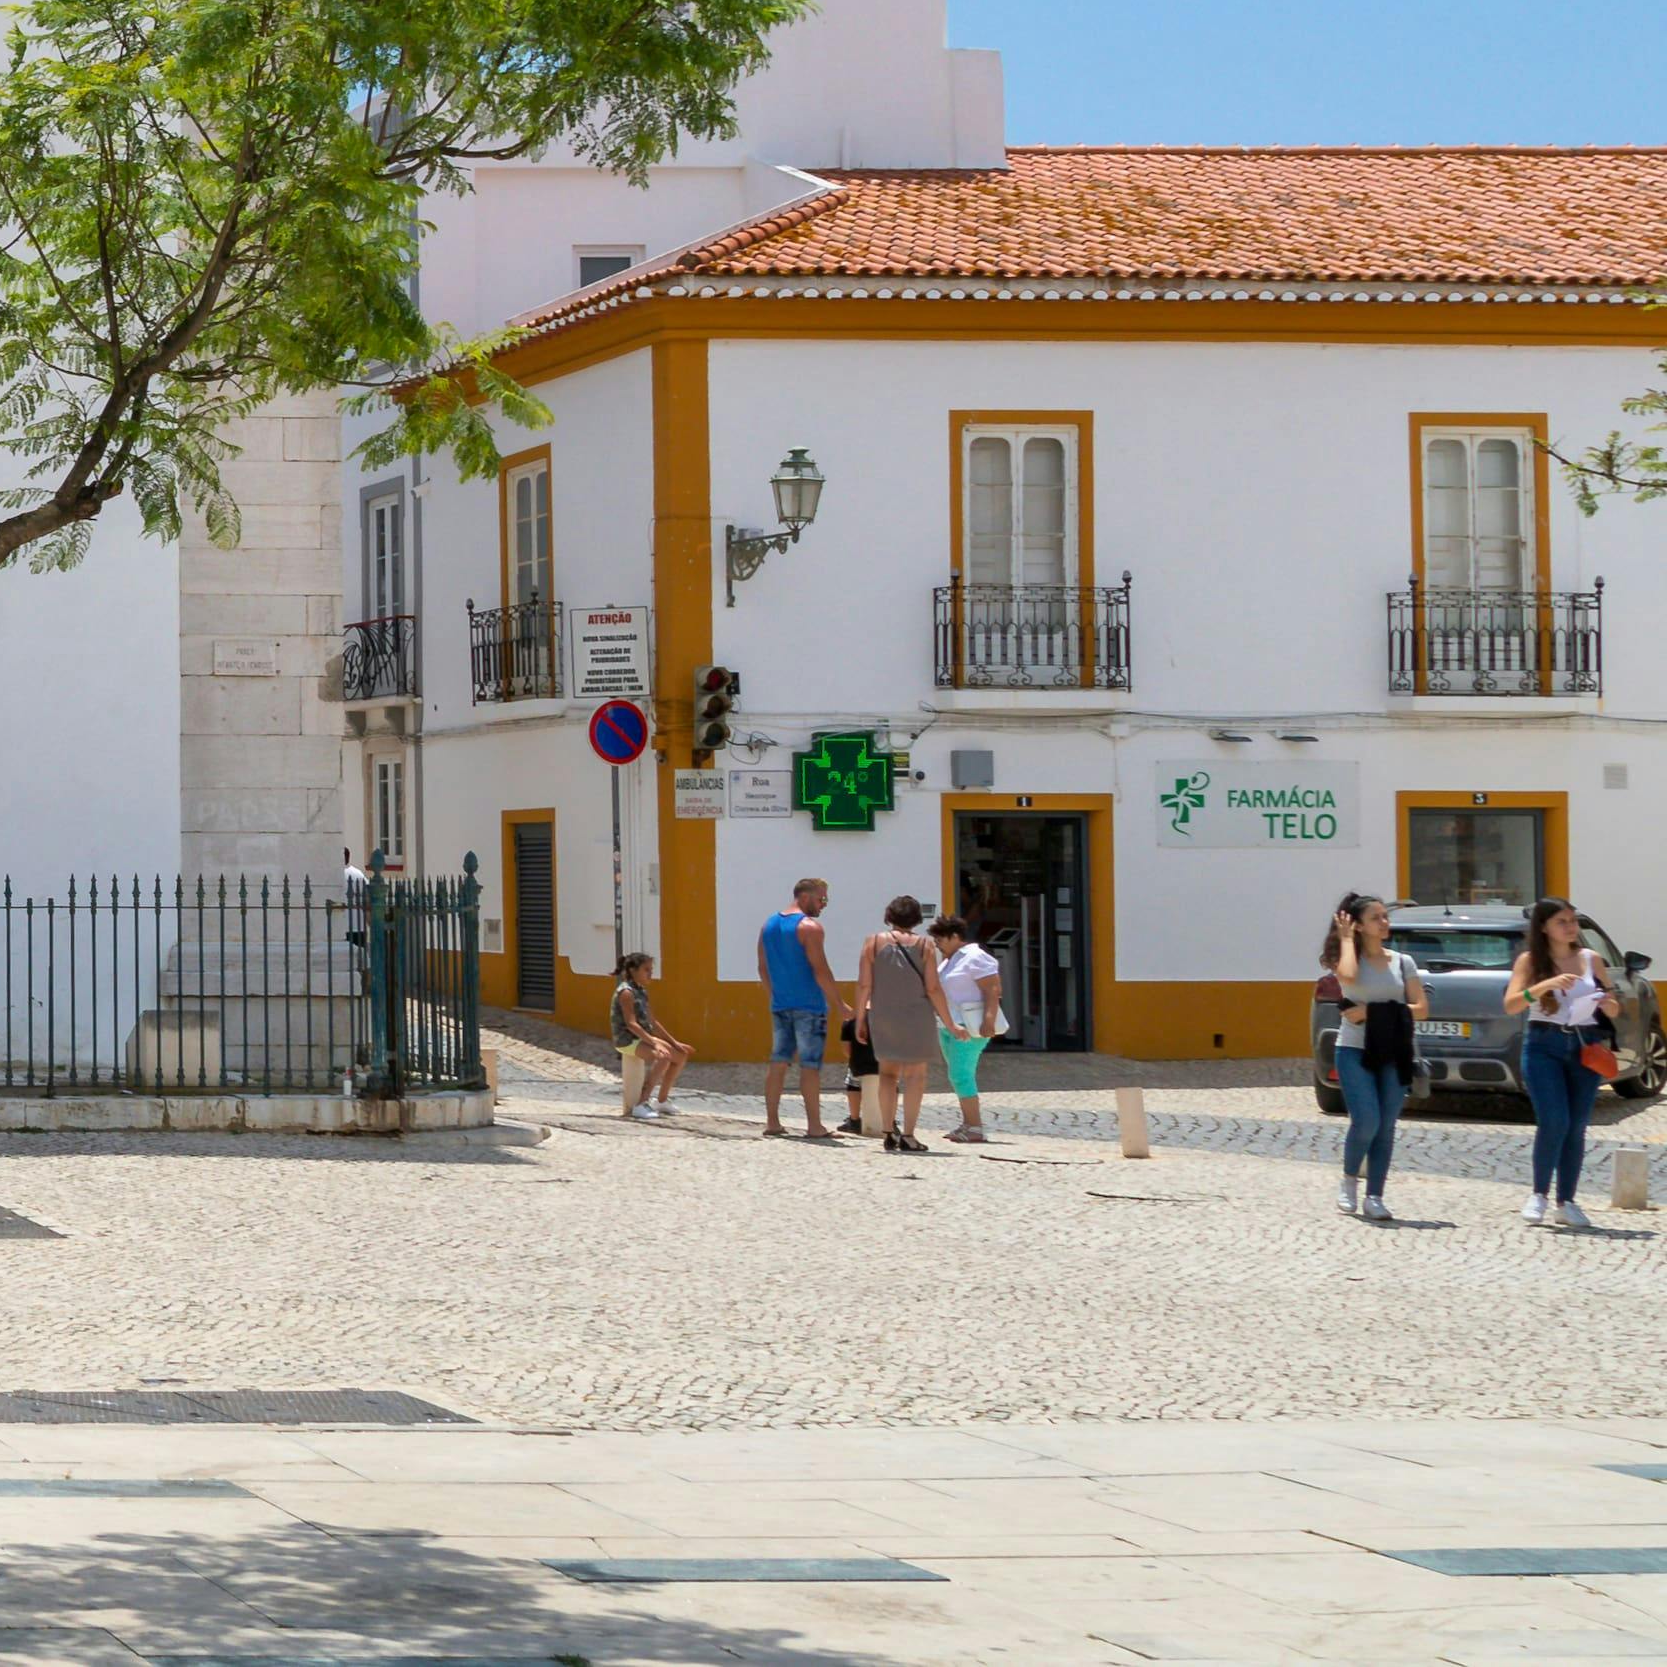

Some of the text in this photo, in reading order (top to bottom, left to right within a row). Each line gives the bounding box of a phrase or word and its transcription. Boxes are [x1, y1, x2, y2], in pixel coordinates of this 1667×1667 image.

[588, 611, 632, 626] ATENÇÃO
[752, 777, 770, 786] Rua
[1227, 785, 1336, 808] FARMÁCIA
[1262, 813, 1337, 839] TELO
